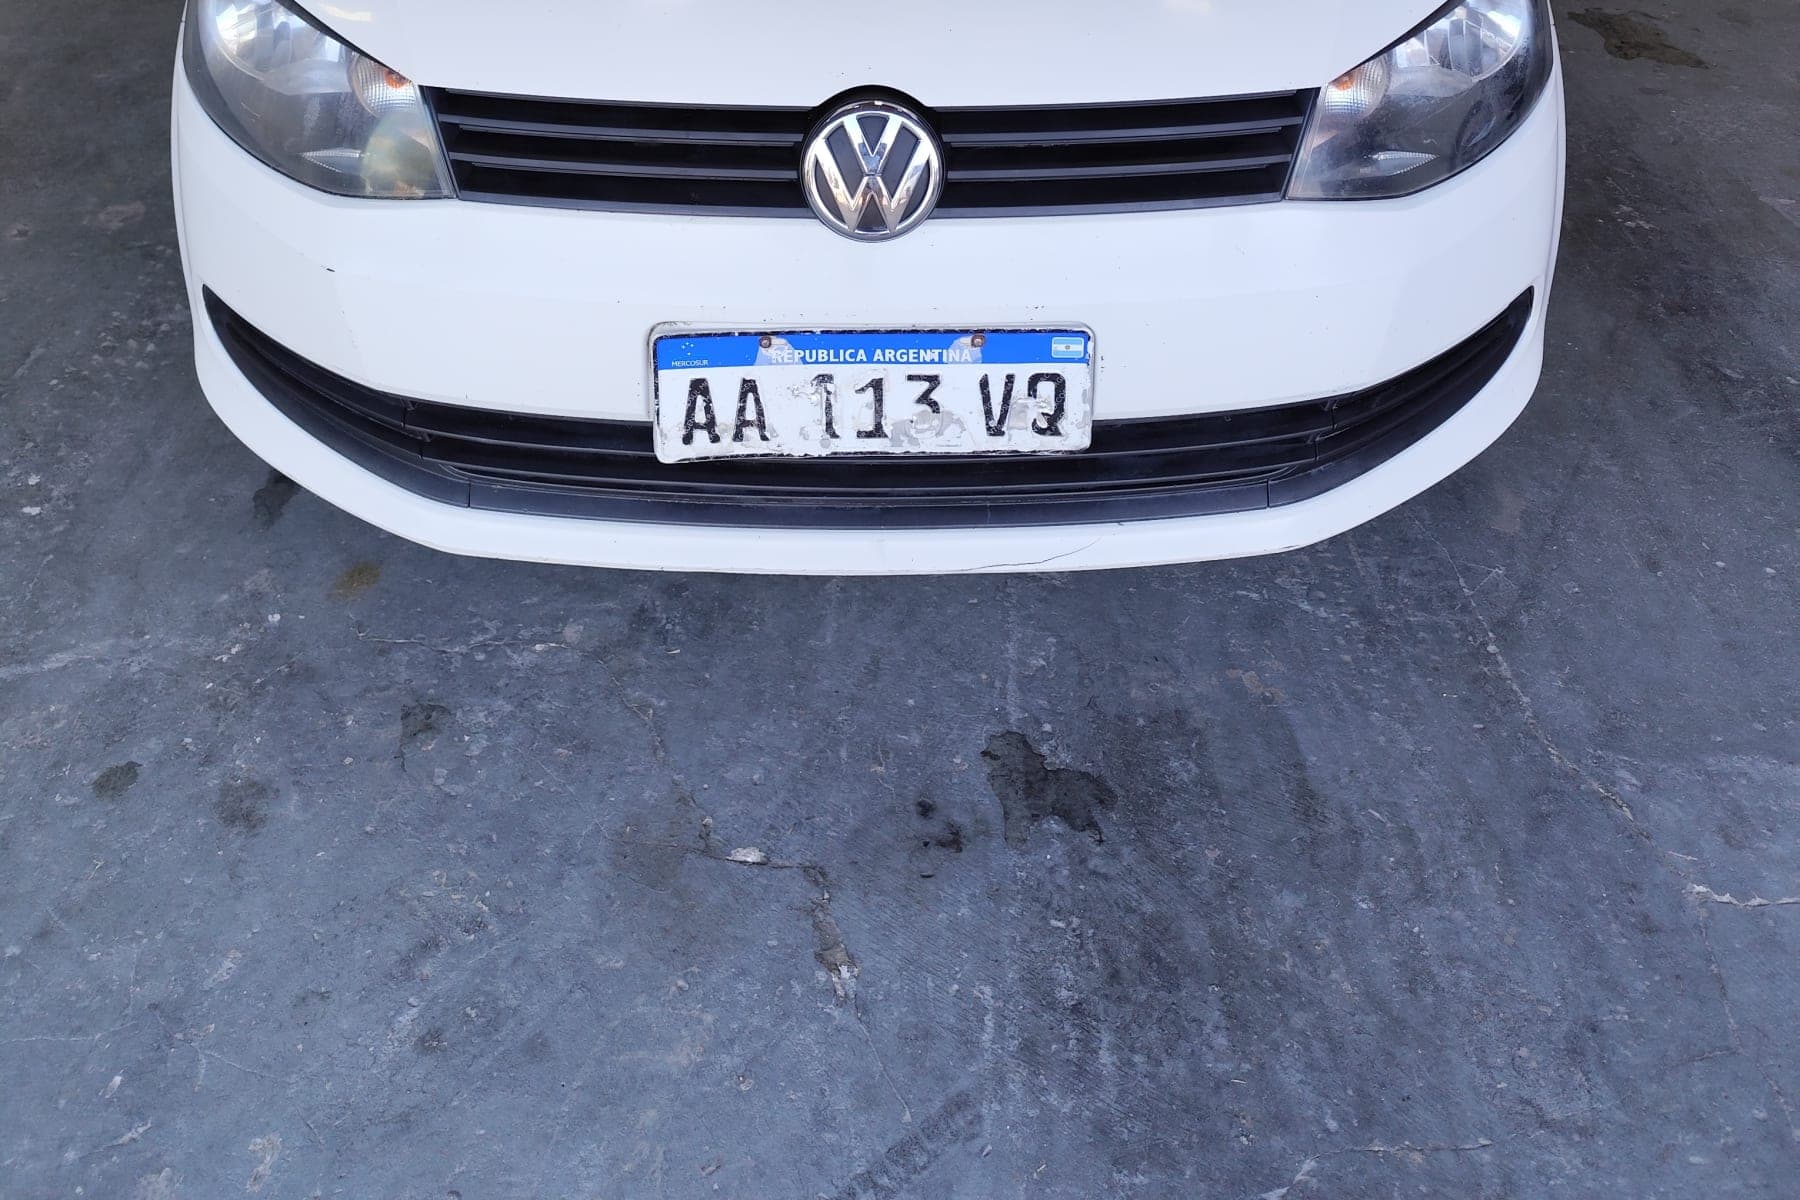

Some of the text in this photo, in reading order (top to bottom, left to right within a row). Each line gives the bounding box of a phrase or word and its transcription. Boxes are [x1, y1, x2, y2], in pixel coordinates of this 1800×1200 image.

[772, 348, 972, 363] REPUBLICA ARGENTINA
[671, 359, 709, 368] MERCOSUR
[682, 372, 1067, 445] AA 113 VQ
